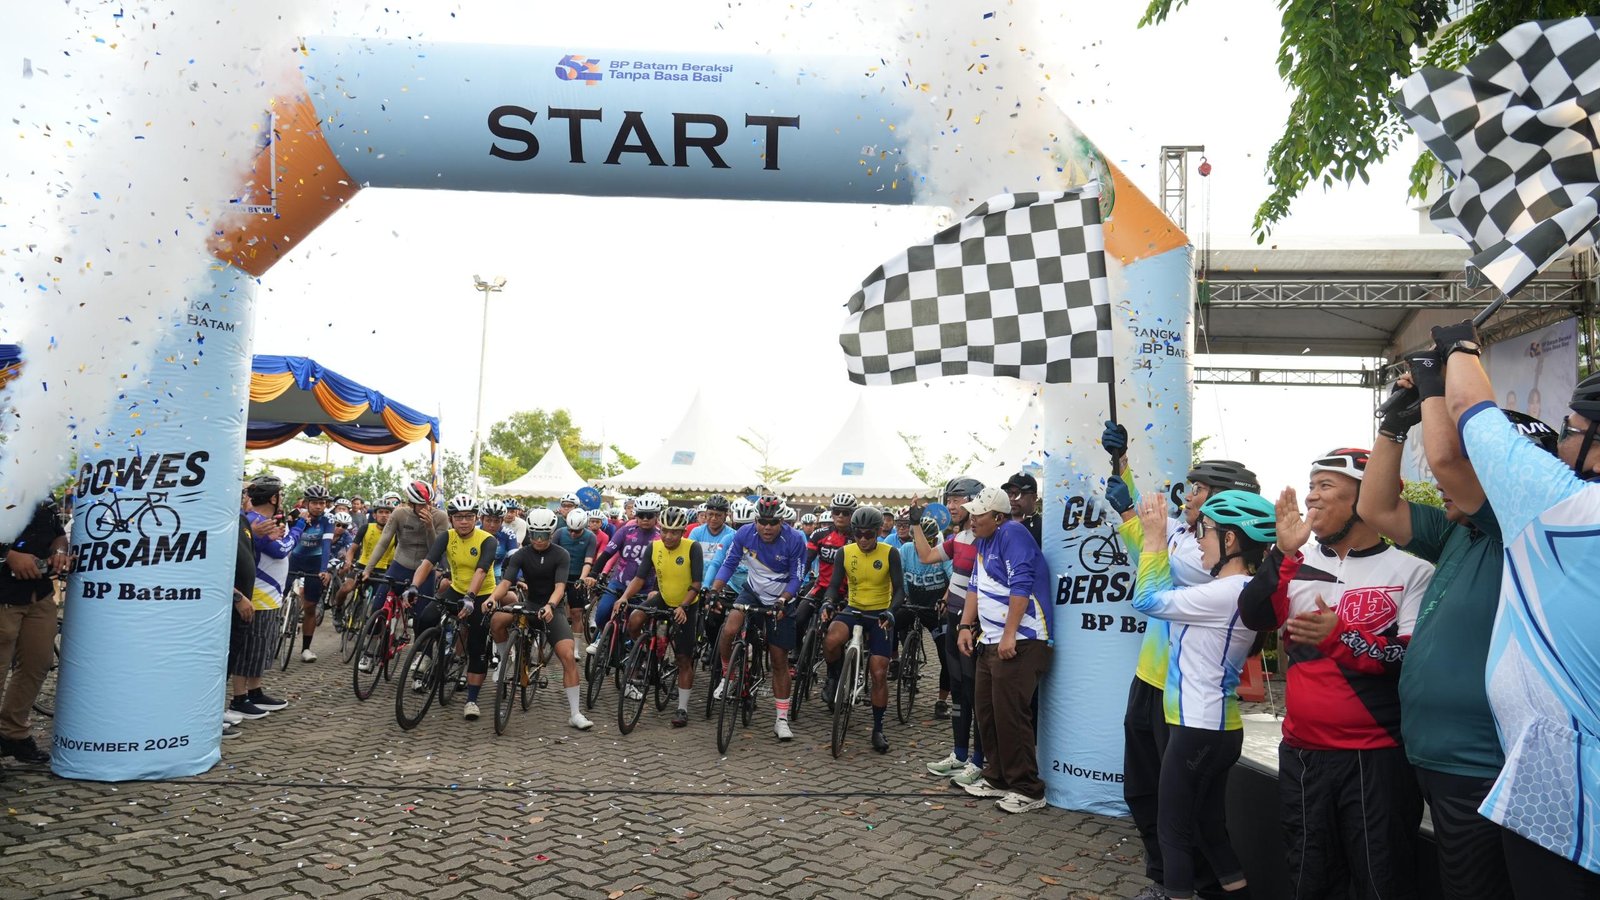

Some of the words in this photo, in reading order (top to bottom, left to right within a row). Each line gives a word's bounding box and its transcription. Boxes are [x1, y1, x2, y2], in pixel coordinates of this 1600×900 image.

[609, 60, 630, 69] BP
[633, 61, 678, 71] Batam
[682, 63, 733, 73] Beraksi
[609, 70, 650, 82] Tanpa
[654, 71, 689, 81] Basa
[692, 72, 722, 83] Basi
[487, 105, 801, 171] START
[187, 314, 235, 333] BATAM
[1142, 342, 1163, 354] BP
[77, 450, 210, 498] GOWES
[82, 581, 112, 600] BP
[117, 583, 202, 601] Batam
[1081, 612, 1114, 631] BP
[60, 736, 140, 752] NOVEMBER
[144, 734, 190, 751] 2025
[1052, 759, 1061, 772] 2
